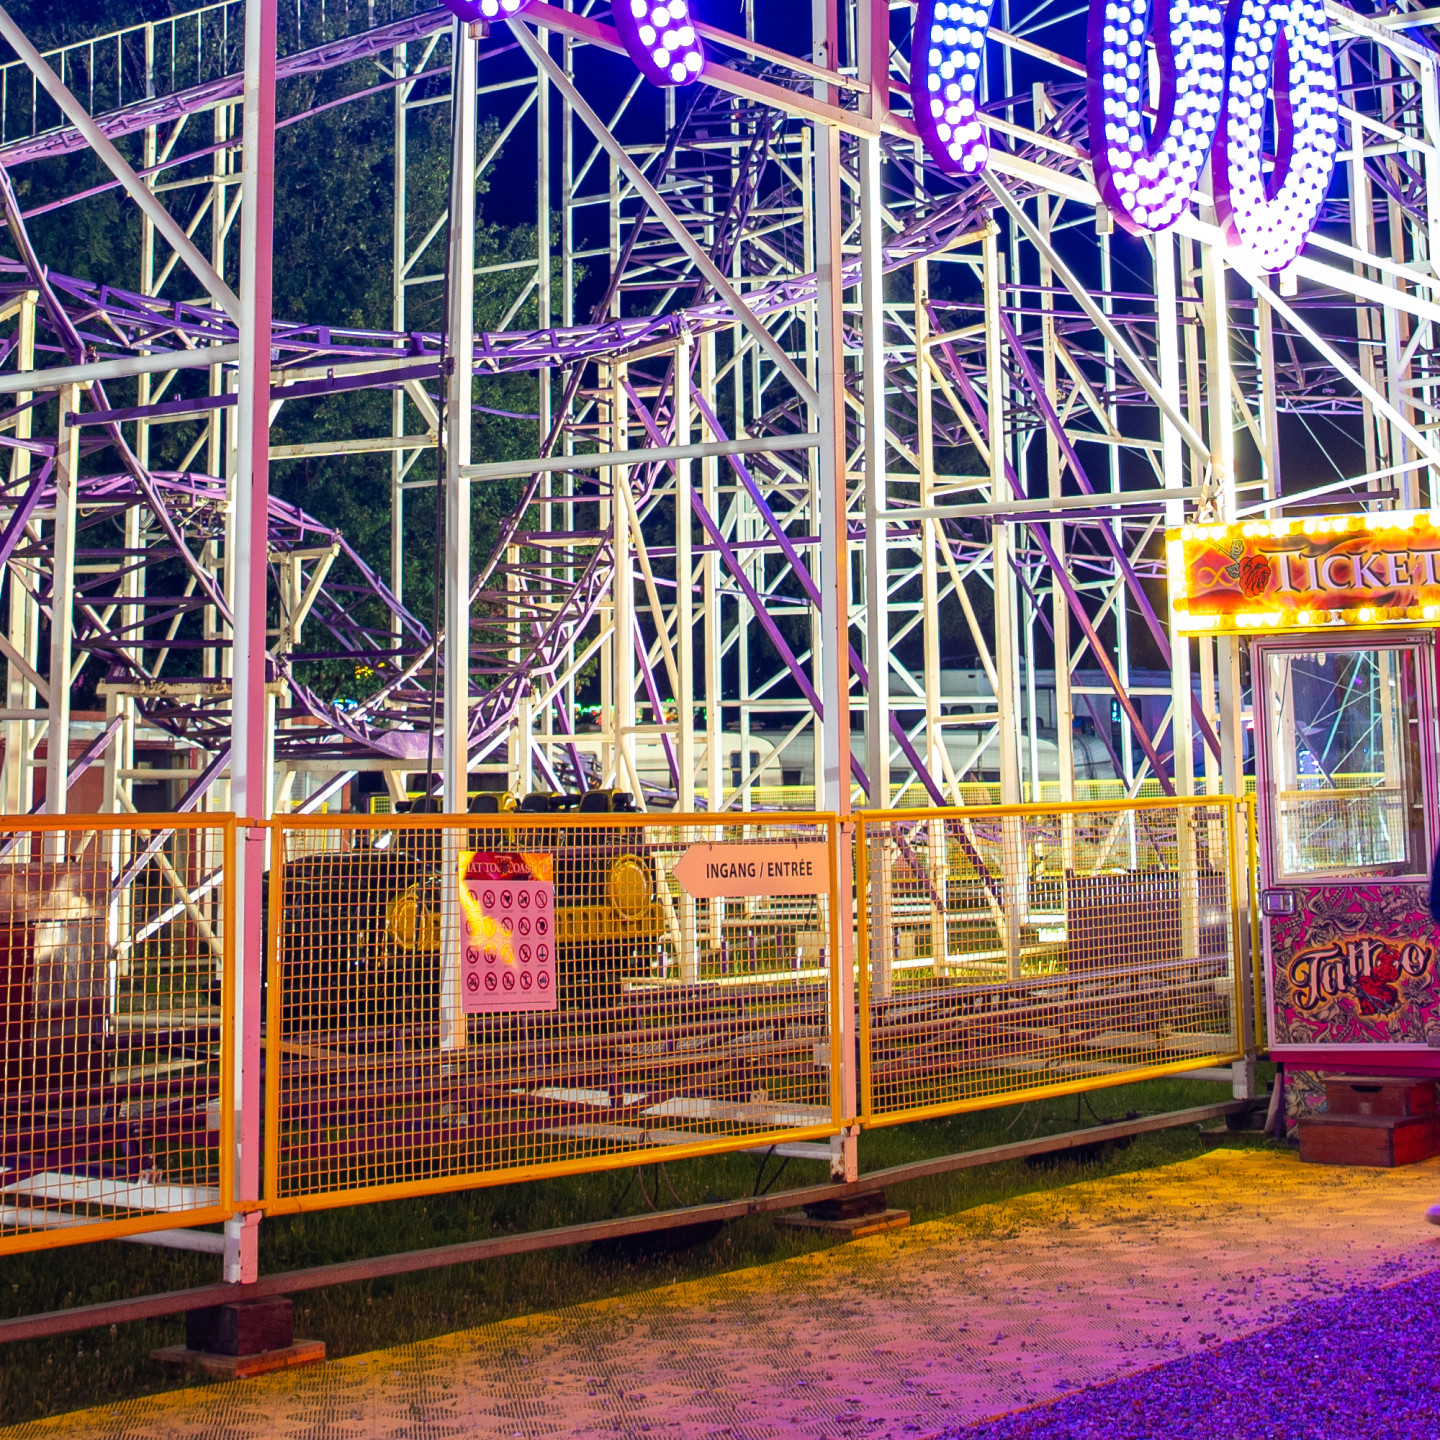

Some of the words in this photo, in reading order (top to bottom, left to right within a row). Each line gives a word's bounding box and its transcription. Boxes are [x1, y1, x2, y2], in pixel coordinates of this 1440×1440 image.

[706, 863, 756, 879] INGANG
[767, 859, 813, 877] ENTRÉE
[1289, 937, 1433, 1011] Tatto
